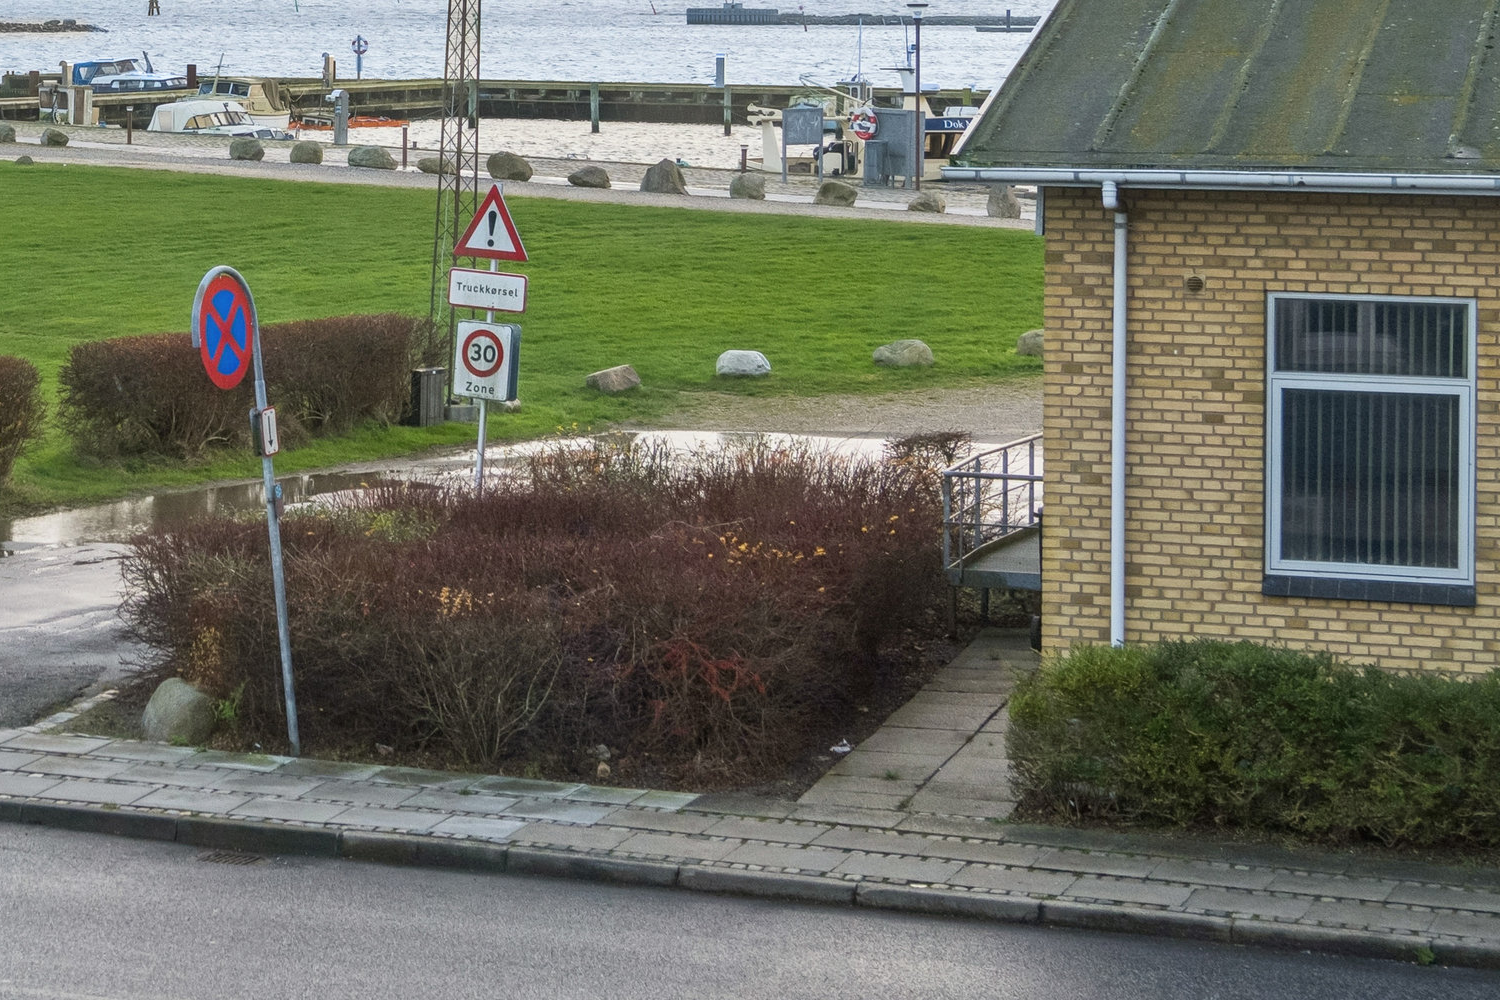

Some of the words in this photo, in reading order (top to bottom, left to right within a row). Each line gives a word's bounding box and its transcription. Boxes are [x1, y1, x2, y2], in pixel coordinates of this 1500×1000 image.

[943, 119, 965, 129] Dok
[456, 281, 519, 298] Truckkørsel
[470, 343, 497, 363] 30
[465, 381, 495, 395] Zone
